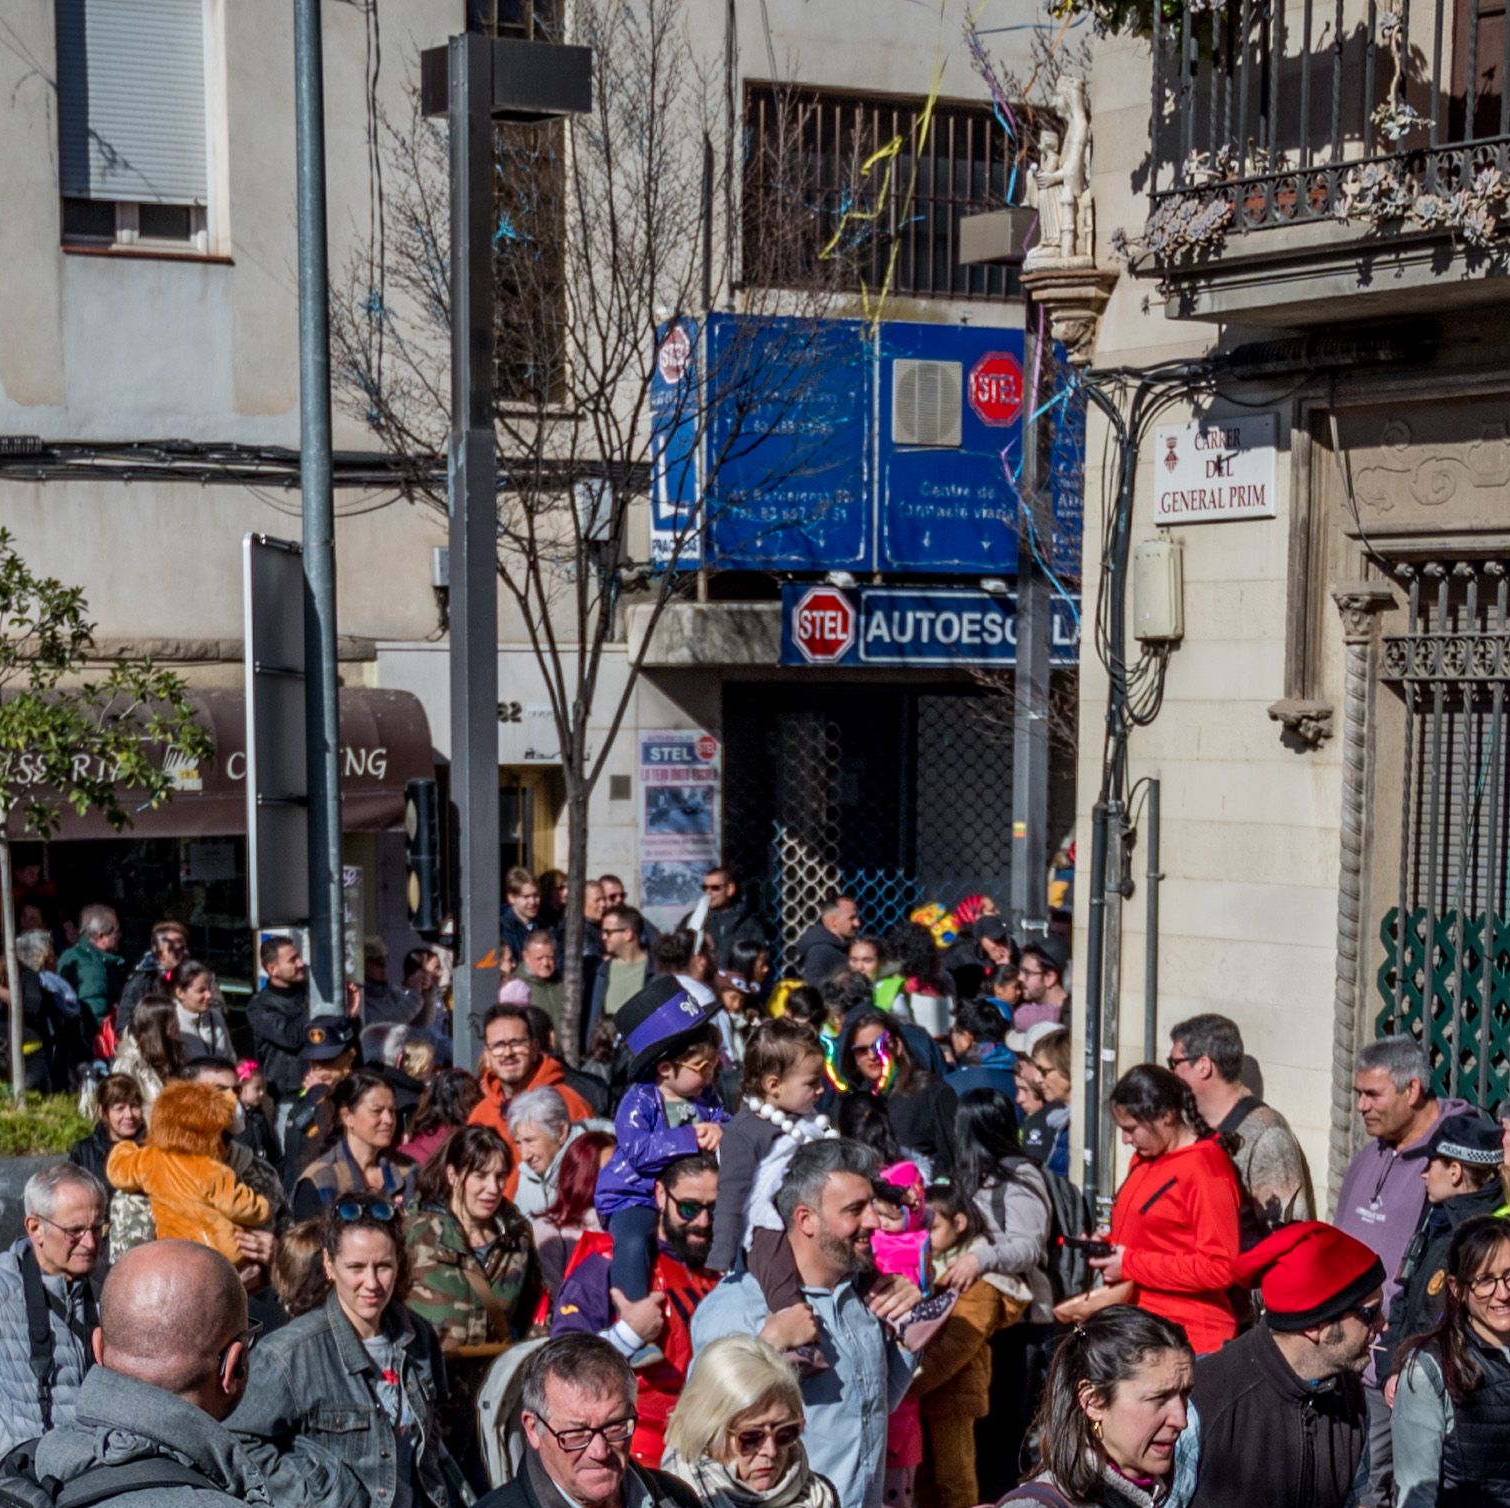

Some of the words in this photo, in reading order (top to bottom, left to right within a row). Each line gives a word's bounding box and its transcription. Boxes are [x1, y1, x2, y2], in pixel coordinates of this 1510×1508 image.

[977, 373, 1020, 405] STEL
[1194, 428, 1241, 451] CARRER
[1205, 457, 1234, 478] DEL
[1161, 488, 1226, 513] GENERAL
[1229, 484, 1266, 508] PRIM
[799, 610, 848, 641] STEL
[865, 610, 1081, 647] AUTOESCL
[650, 747, 692, 761] STEL
